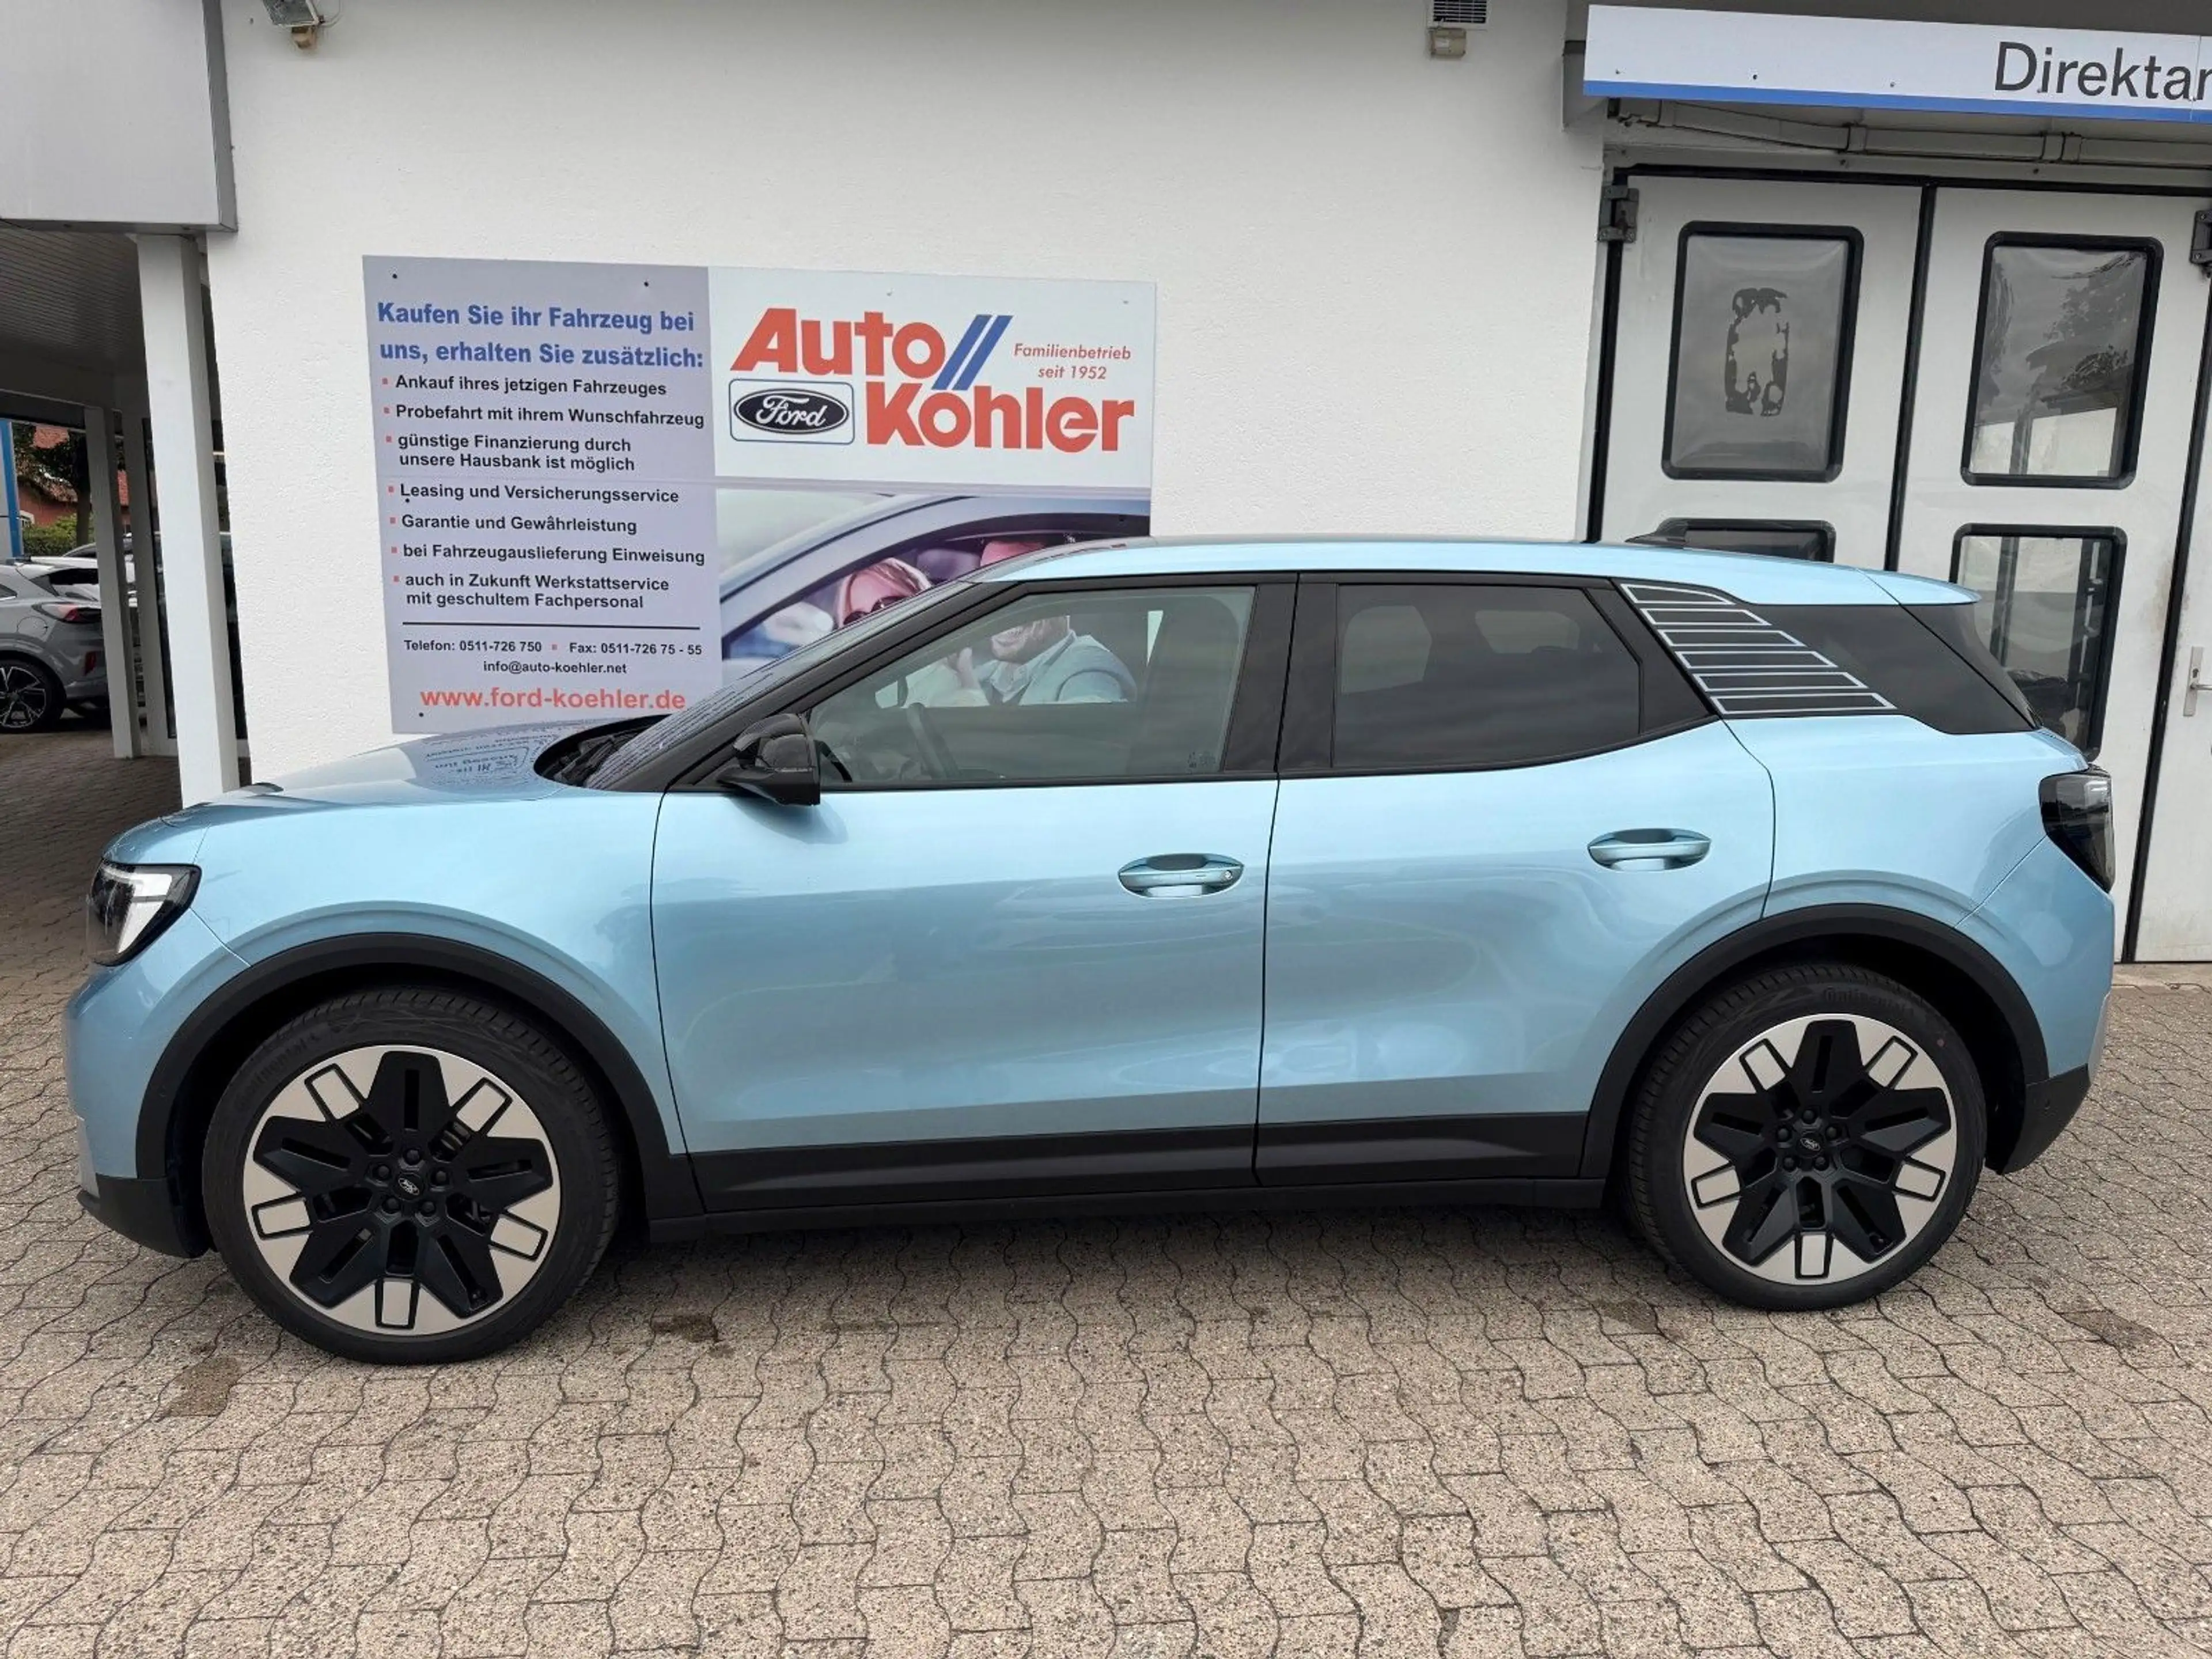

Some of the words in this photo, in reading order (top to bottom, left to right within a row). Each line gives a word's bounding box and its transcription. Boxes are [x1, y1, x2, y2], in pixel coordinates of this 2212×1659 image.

[378, 302, 459, 324] Kaufen
[468, 304, 503, 324] Sie
[512, 306, 541, 326] ihr
[549, 307, 652, 334] Fahrzeug
[660, 311, 694, 331] bei
[730, 308, 946, 377] Auto
[1014, 343, 1131, 359] Familienbetrieb
[380, 343, 428, 364] uns,
[436, 342, 531, 362] erhalten
[539, 344, 574, 363] Sie
[582, 346, 703, 367] zusätzlich:
[1039, 365, 1065, 378] seit
[1071, 366, 1107, 380] 1952
[395, 375, 454, 389] Ankauf
[459, 376, 499, 391] ihres
[504, 378, 567, 395] jetzigen
[573, 379, 666, 397] Fahrzeuges
[396, 404, 483, 420] Probefahrt
[488, 407, 513, 420] mit
[518, 408, 563, 422] ihrem
[568, 408, 704, 429] Wunschfahrzeug
[756, 395, 828, 426] Ford
[399, 435, 469, 450] günstige
[474, 435, 579, 453] Finanzierung
[585, 439, 631, 452] durch
[400, 455, 454, 467] unsere
[460, 453, 541, 469] Hausbank
[546, 456, 566, 469] ist
[571, 457, 634, 472] möglich
[400, 484, 464, 501] Leasing
[469, 485, 499, 497] und
[505, 485, 679, 502] Versicherungsservice
[402, 514, 469, 528] Garantie
[476, 517, 505, 529] und
[403, 544, 427, 557] bei
[433, 545, 607, 563] Fahrzeugauslieferung
[612, 548, 705, 566] Einweisung
[405, 573, 444, 587] auch
[450, 574, 463, 588] in
[468, 574, 531, 588] Zukunft
[536, 575, 669, 590] Werkstattservice
[407, 592, 432, 605] mit
[437, 592, 529, 607] geschultem
[535, 593, 643, 609] Fachpersonal
[404, 640, 455, 652] Telefon:
[460, 640, 516, 652] 0511-726
[520, 641, 541, 652] 750
[569, 642, 596, 653] Fax:
[601, 642, 657, 654] 0511-726
[661, 643, 676, 654] 75
[687, 643, 702, 655] 55
[483, 661, 627, 674] info@auto-koehler.net
[421, 687, 685, 709] www.ford-koehler.de
